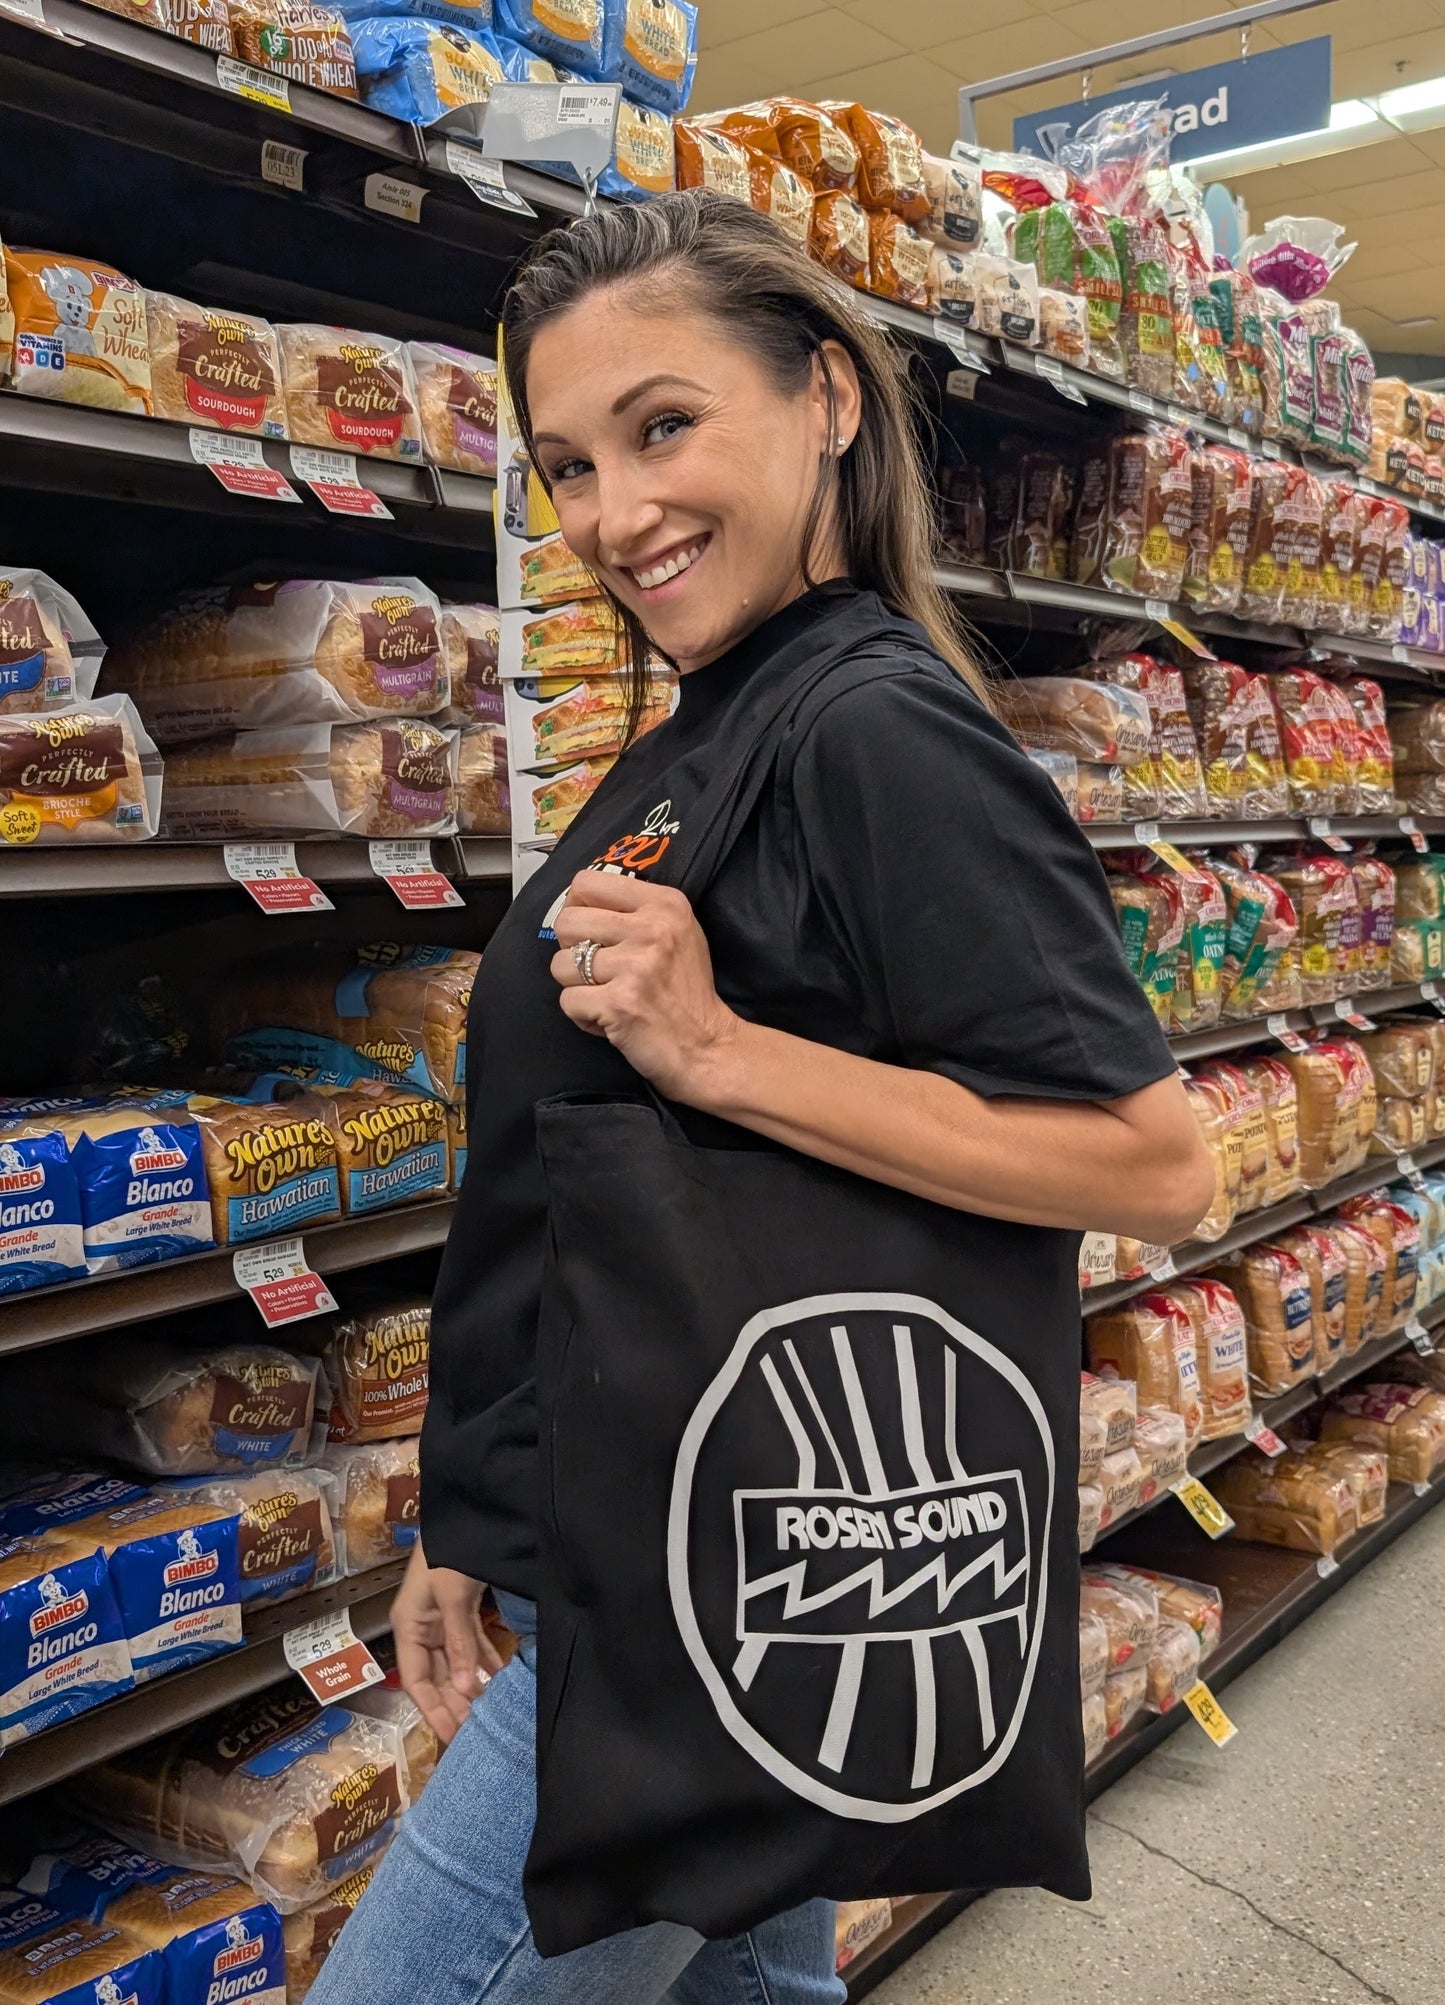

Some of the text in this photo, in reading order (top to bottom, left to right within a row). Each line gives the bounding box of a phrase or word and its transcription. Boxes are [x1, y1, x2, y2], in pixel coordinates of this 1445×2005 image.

[265, 30, 283, 47] 16
[641, 18, 676, 50] WHITE
[290, 36, 333, 62] 100%
[644, 38, 670, 57] BREAD
[320, 62, 358, 90] WHEAT
[376, 191, 400, 208] Section
[382, 182, 398, 195] Aisle
[112, 298, 146, 333] Soft
[19, 339, 63, 353] VITAMINS
[103, 325, 151, 364] Whea
[217, 329, 246, 348] Own
[210, 349, 250, 366] PERFECTLY
[354, 357, 381, 374] Own
[194, 354, 262, 391] Crafted
[348, 376, 389, 390] PERFECTLY
[197, 395, 256, 419] SOURDOUGH
[334, 385, 399, 413] Crafted
[464, 397, 498, 427] Craf
[341, 424, 394, 439] SOURDOUGH
[460, 431, 498, 451] MULTIG
[219, 468, 279, 483] No Artificial
[335, 489, 372, 500] Artificial
[372, 595, 416, 619] Nature's
[387, 606, 411, 625] Own
[387, 625, 419, 637] PERFECTLY
[379, 633, 430, 666] Crafted
[381, 670, 433, 688] MULTIGRAIN
[30, 712, 97, 739] Nature's
[49, 725, 85, 748] Own
[42, 748, 94, 763] PERFECTLY
[20, 756, 111, 788] Crafted
[397, 758, 445, 785] Crafted
[43, 797, 91, 810] BRIOCHE
[55, 808, 81, 819] STYLE
[393, 794, 442, 811] MULTIGRAIN
[3, 809, 29, 822] Soft
[6, 820, 38, 836] Sweet
[254, 882, 310, 893] No Artificial
[395, 879, 444, 889] No Artificial
[1203, 943, 1225, 958] OATN
[344, 1100, 445, 1153] Nature's
[227, 1119, 335, 1178] Nature's
[375, 1120, 429, 1166] Own
[134, 1152, 186, 1172] BIMBO
[256, 1144, 316, 1194] Own
[361, 1151, 440, 1196] Hawaiian
[0, 1173, 42, 1191] IMBO
[126, 1177, 194, 1206] Blanco
[240, 1176, 330, 1225] Hawaiian
[0, 1199, 55, 1228] lanco
[125, 1216, 192, 1236] Large White Bread
[142, 1206, 180, 1222] Grande
[6, 1240, 56, 1260] White Bread
[261, 1281, 317, 1300] No Artificial
[365, 1320, 431, 1364] Natur
[1214, 1339, 1244, 1357] WHITE
[364, 1390, 388, 1403] 100%
[387, 1376, 422, 1401] Whole
[229, 1404, 296, 1429] Crafted
[237, 1440, 271, 1452] WHITE
[243, 1492, 298, 1527] Nature's
[257, 1508, 288, 1533] Own
[776, 1491, 1008, 1551] ROSEN SOUND
[256, 1526, 299, 1547] PERFECTLY
[242, 1530, 311, 1573] Crafted
[167, 1555, 216, 1584] BIMBO
[261, 1570, 298, 1592] WHITE
[159, 1582, 225, 1618] Blanco
[33, 1596, 86, 1633] BIMBO
[173, 1612, 209, 1632] Grande
[27, 1622, 98, 1670] Blanco
[157, 1620, 223, 1648] Large White Bread
[28, 1660, 99, 1700] Large White Bread
[44, 1655, 83, 1681] Grande
[315, 1661, 348, 1679] Whole
[325, 1671, 352, 1687] Grain
[291, 1729, 329, 1754] WHITE
[330, 1763, 378, 1807] Nature's
[344, 1782, 370, 1811] Own
[344, 1798, 379, 1827] PERFECTLY
[333, 1796, 391, 1855] Crafted
[345, 1838, 376, 1867] WHITE
[217, 1942, 262, 1972] BIMBO
[207, 1967, 268, 2005] Blanco
